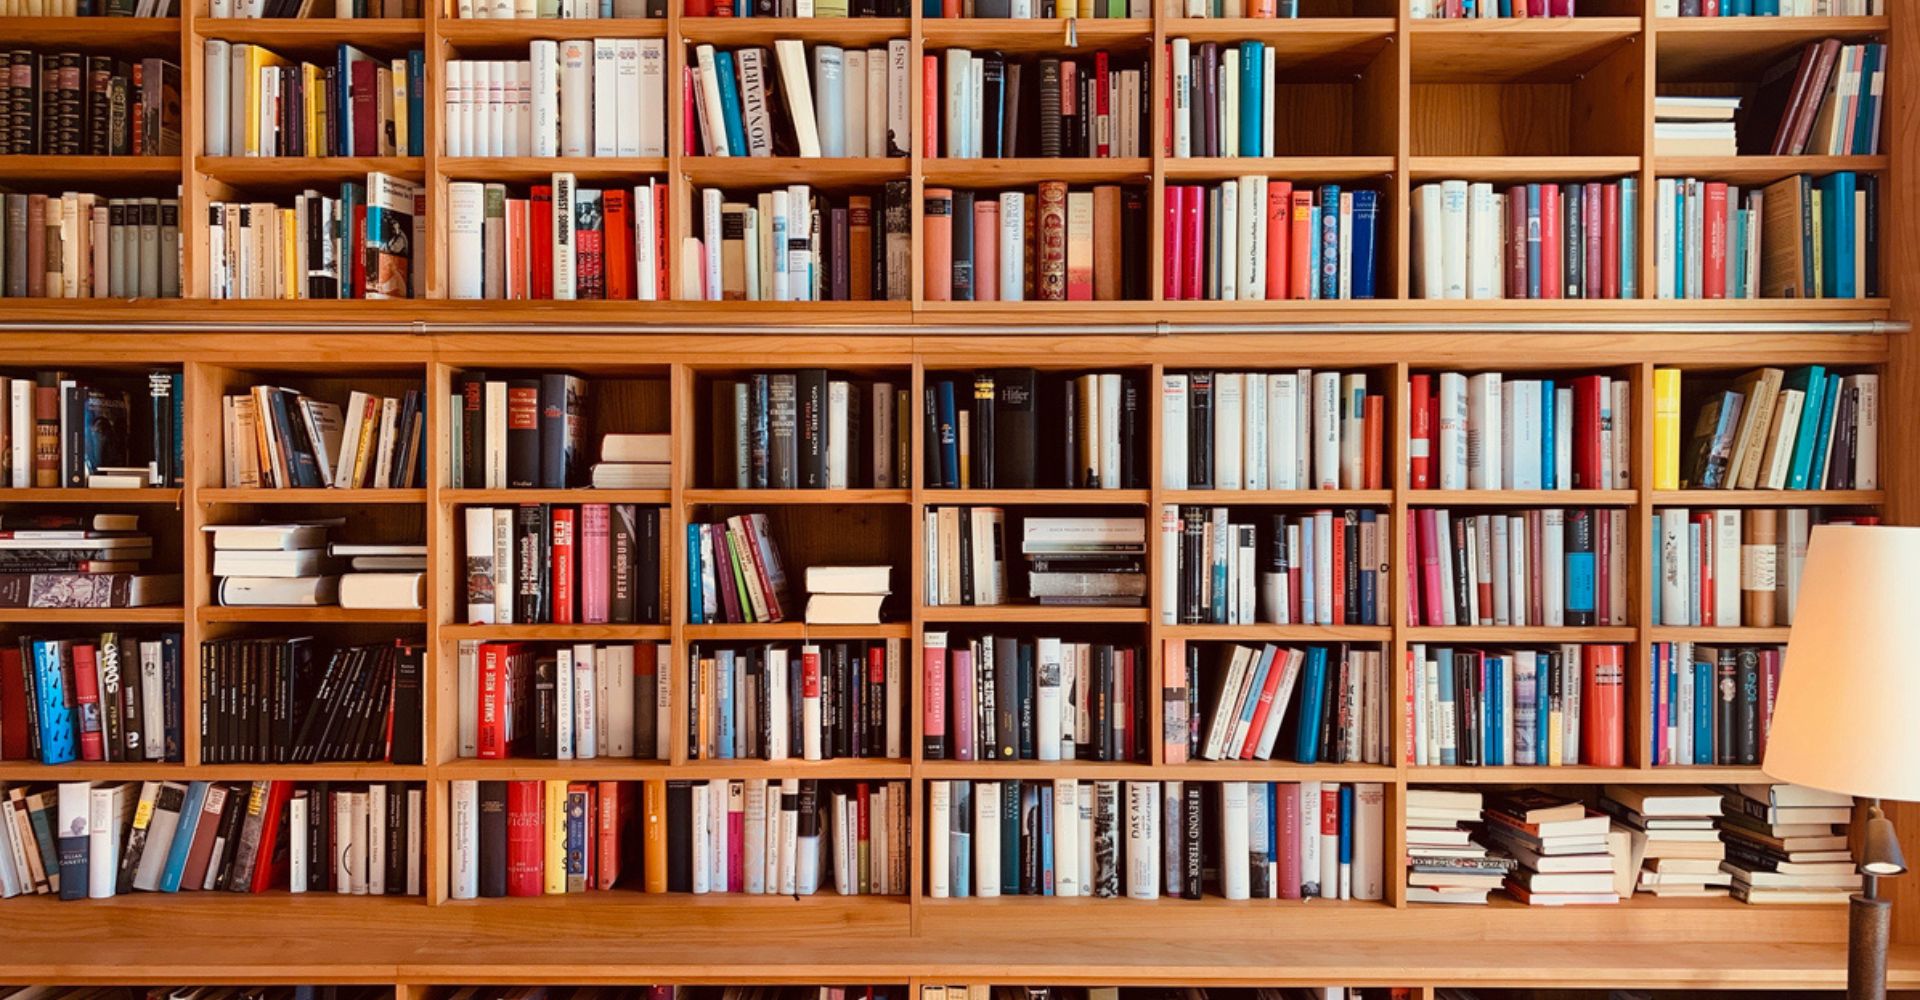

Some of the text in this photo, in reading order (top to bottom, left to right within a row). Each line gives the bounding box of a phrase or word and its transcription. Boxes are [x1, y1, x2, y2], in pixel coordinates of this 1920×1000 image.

[895, 45, 906, 71] 1815
[742, 51, 765, 149] BONAPARTE
[558, 179, 569, 245] HARVEST SORROW
[1002, 389, 1029, 401] Hitler
[554, 520, 565, 545] RED
[617, 531, 627, 599] PETERSBURG
[104, 643, 119, 694] SOUND
[485, 651, 497, 670] WELT
[485, 671, 496, 692] NEUE
[560, 677, 568, 718] PROMISED
[583, 689, 591, 708] WELT
[1022, 697, 1031, 727] Rovan
[1131, 784, 1140, 839] DAS AMT
[1188, 800, 1199, 878] BEYOND TERROR
